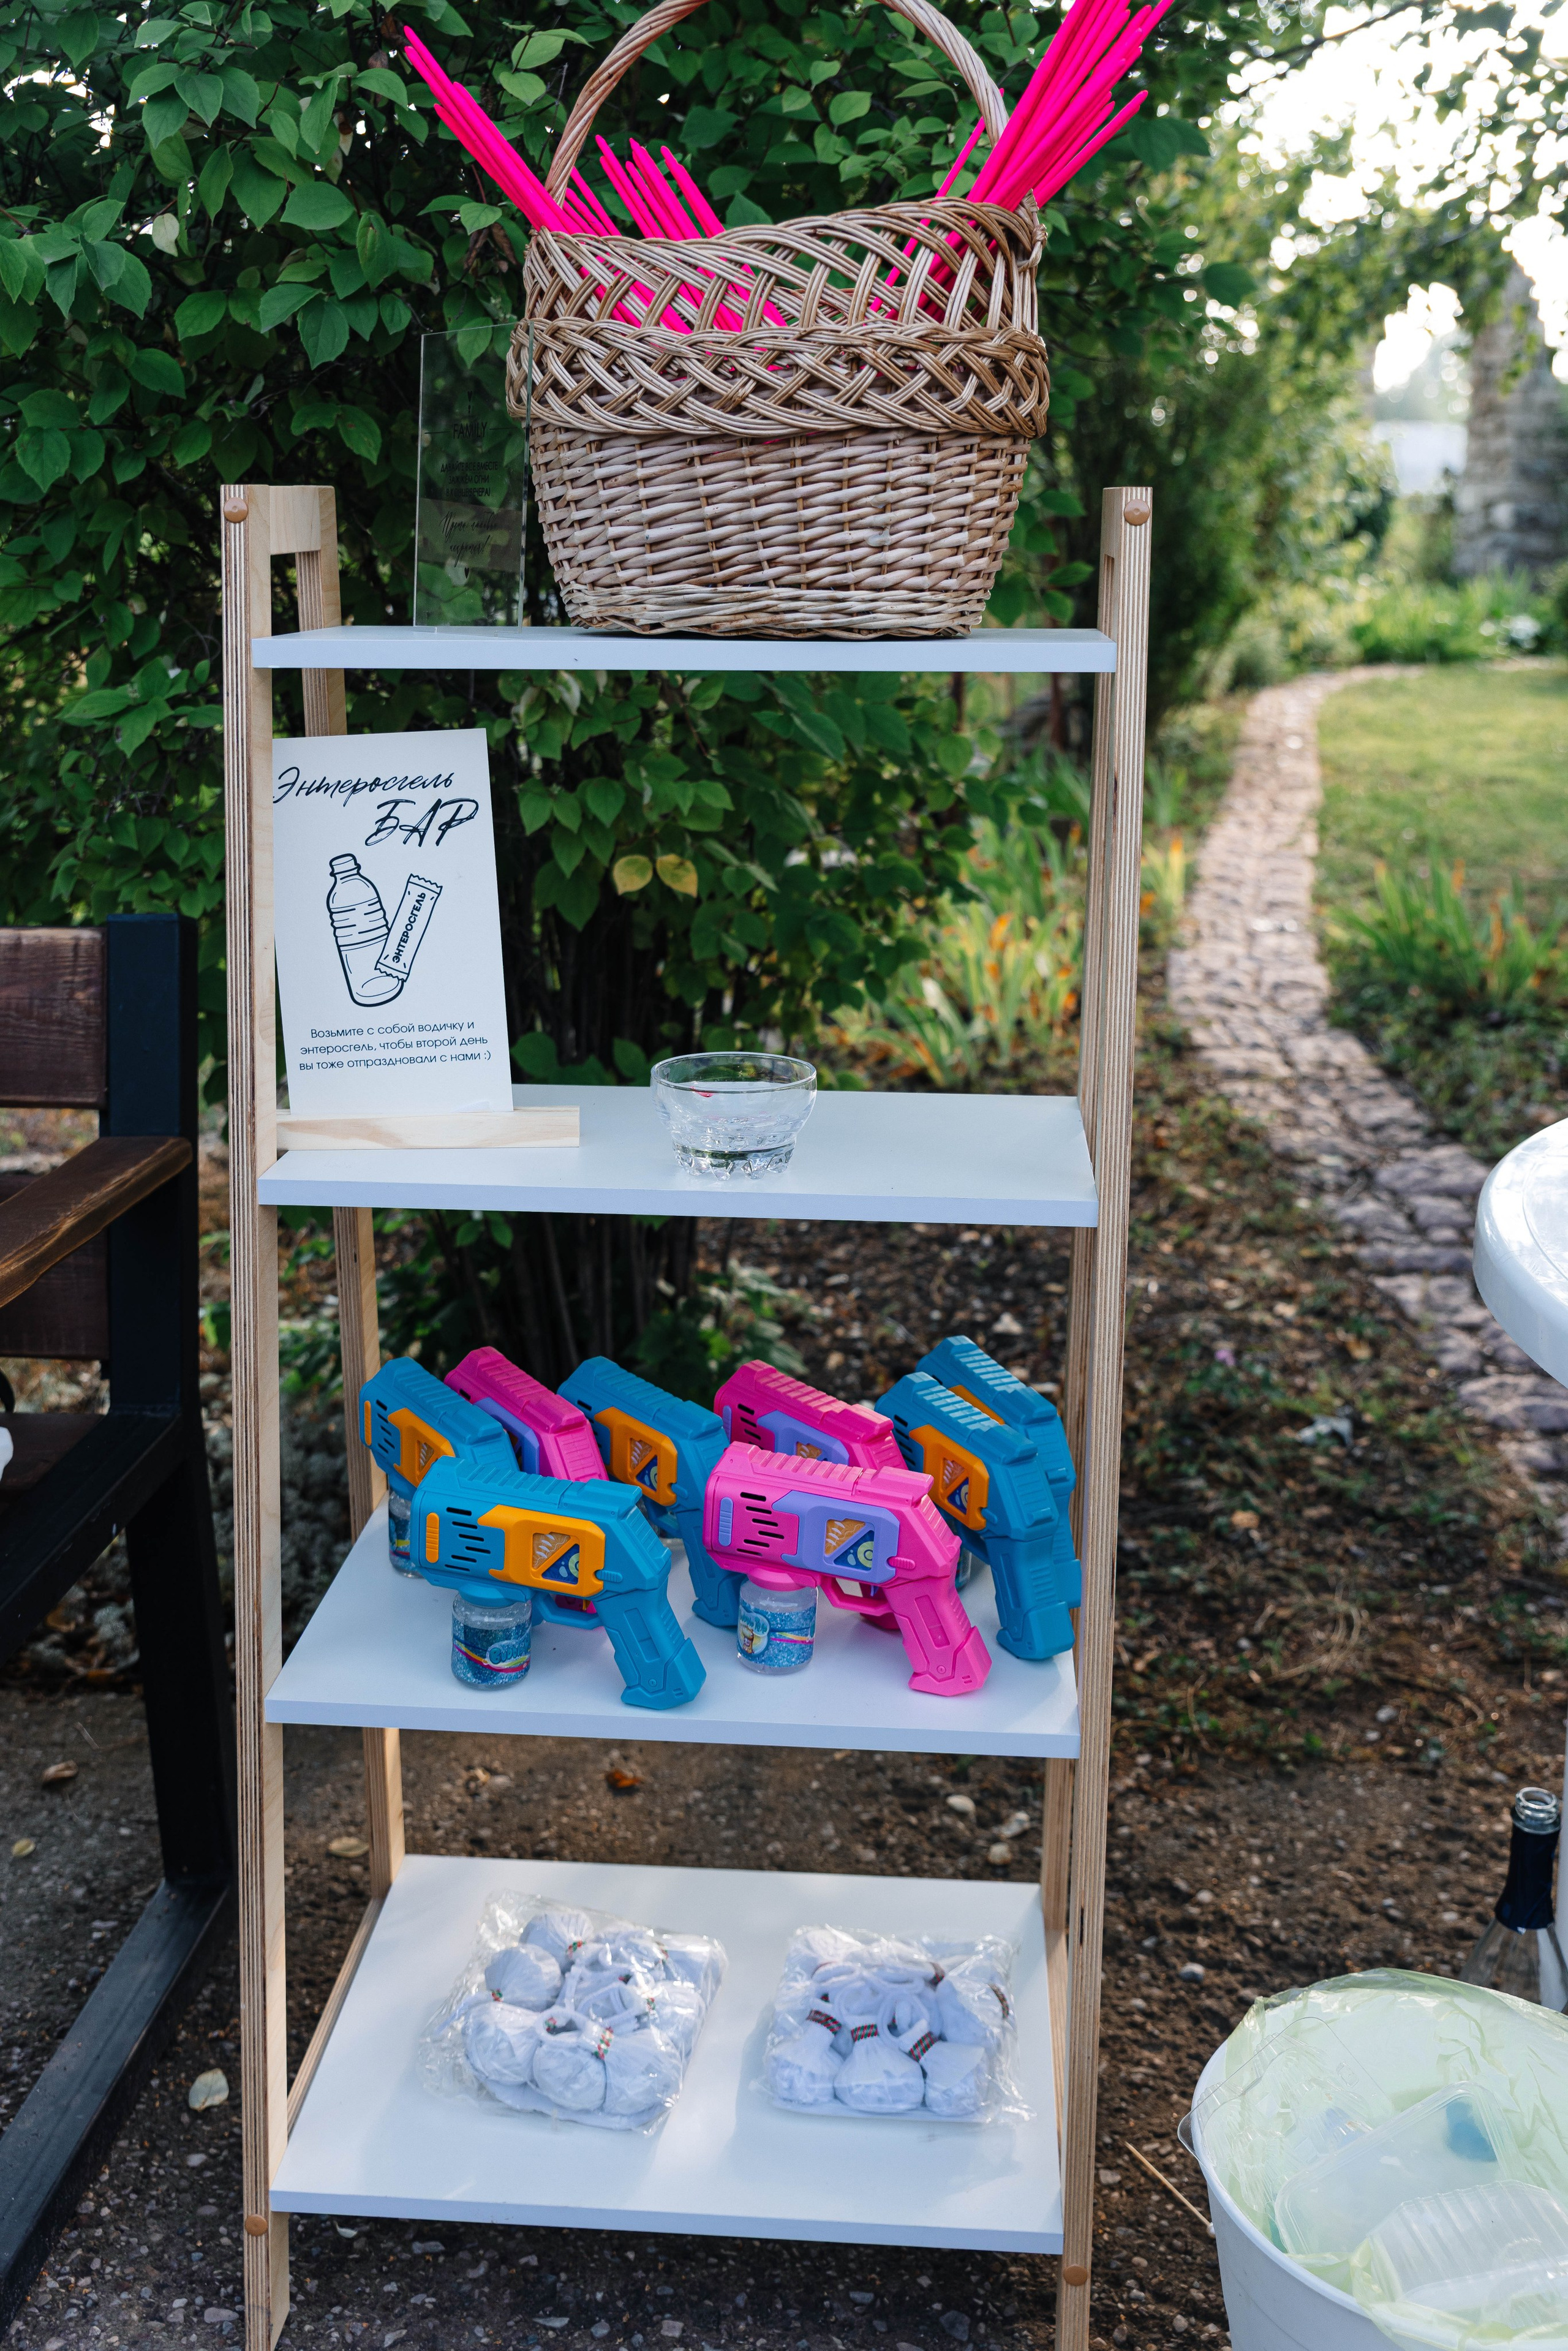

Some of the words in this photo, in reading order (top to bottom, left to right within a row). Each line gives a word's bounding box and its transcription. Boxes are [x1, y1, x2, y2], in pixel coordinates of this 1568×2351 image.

[453, 421, 488, 439] FAMILY
[440, 461, 464, 473] ДАВАЙТЕ
[466, 462, 476, 471] ВСЕ
[477, 461, 498, 470] ВМЕСТЕ
[474, 474, 489, 484] ОГНИ
[273, 766, 454, 807] Энтеросгель
[365, 798, 479, 847] БАР
[392, 892, 426, 964] ЭНТЕРОСГЕЛЬ
[311, 1027, 364, 1038] Возьмите
[377, 1023, 415, 1035] собой
[418, 1021, 464, 1033] водичку
[300, 1044, 377, 1055] энтеросгель,
[379, 1039, 413, 1051] чтобы
[416, 1036, 457, 1049] второй
[460, 1035, 488, 1046] день
[300, 1062, 314, 1071] вы
[316, 1060, 344, 1070] тоже
[347, 1055, 437, 1068] отпраздновали
[450, 1052, 481, 1061] нами
